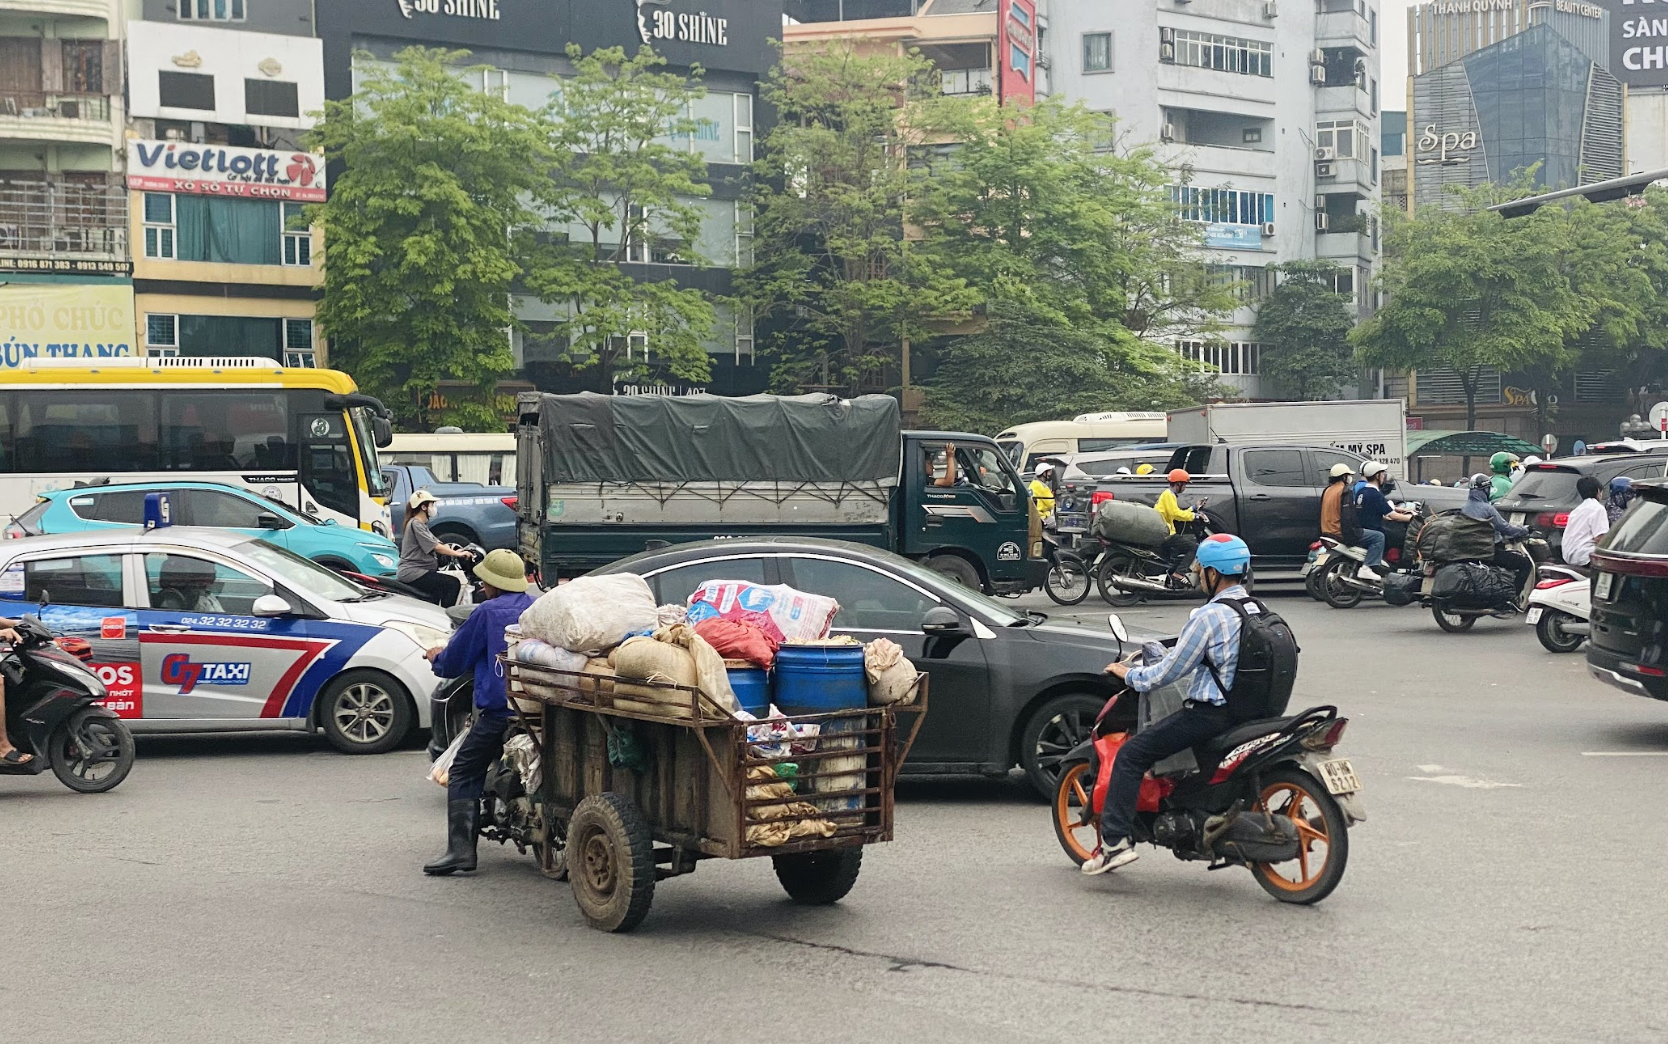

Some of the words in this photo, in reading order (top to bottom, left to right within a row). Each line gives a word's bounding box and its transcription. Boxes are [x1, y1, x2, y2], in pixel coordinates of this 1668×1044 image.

[1432, 3, 1470, 14] THANH
[1581, 6, 1602, 19] CENTER
[653, 10, 675, 39] 30
[679, 12, 728, 45] SHINE
[1418, 123, 1477, 161] Spa
[136, 143, 279, 175] Vietlott
[250, 186, 291, 198] CHỌN
[53, 301, 124, 331] CHÚC
[1366, 443, 1386, 455] SPA
[216, 617, 232, 628] 32
[233, 619, 249, 629] 32
[250, 620, 267, 630] 32
[202, 663, 250, 680] TAXI
